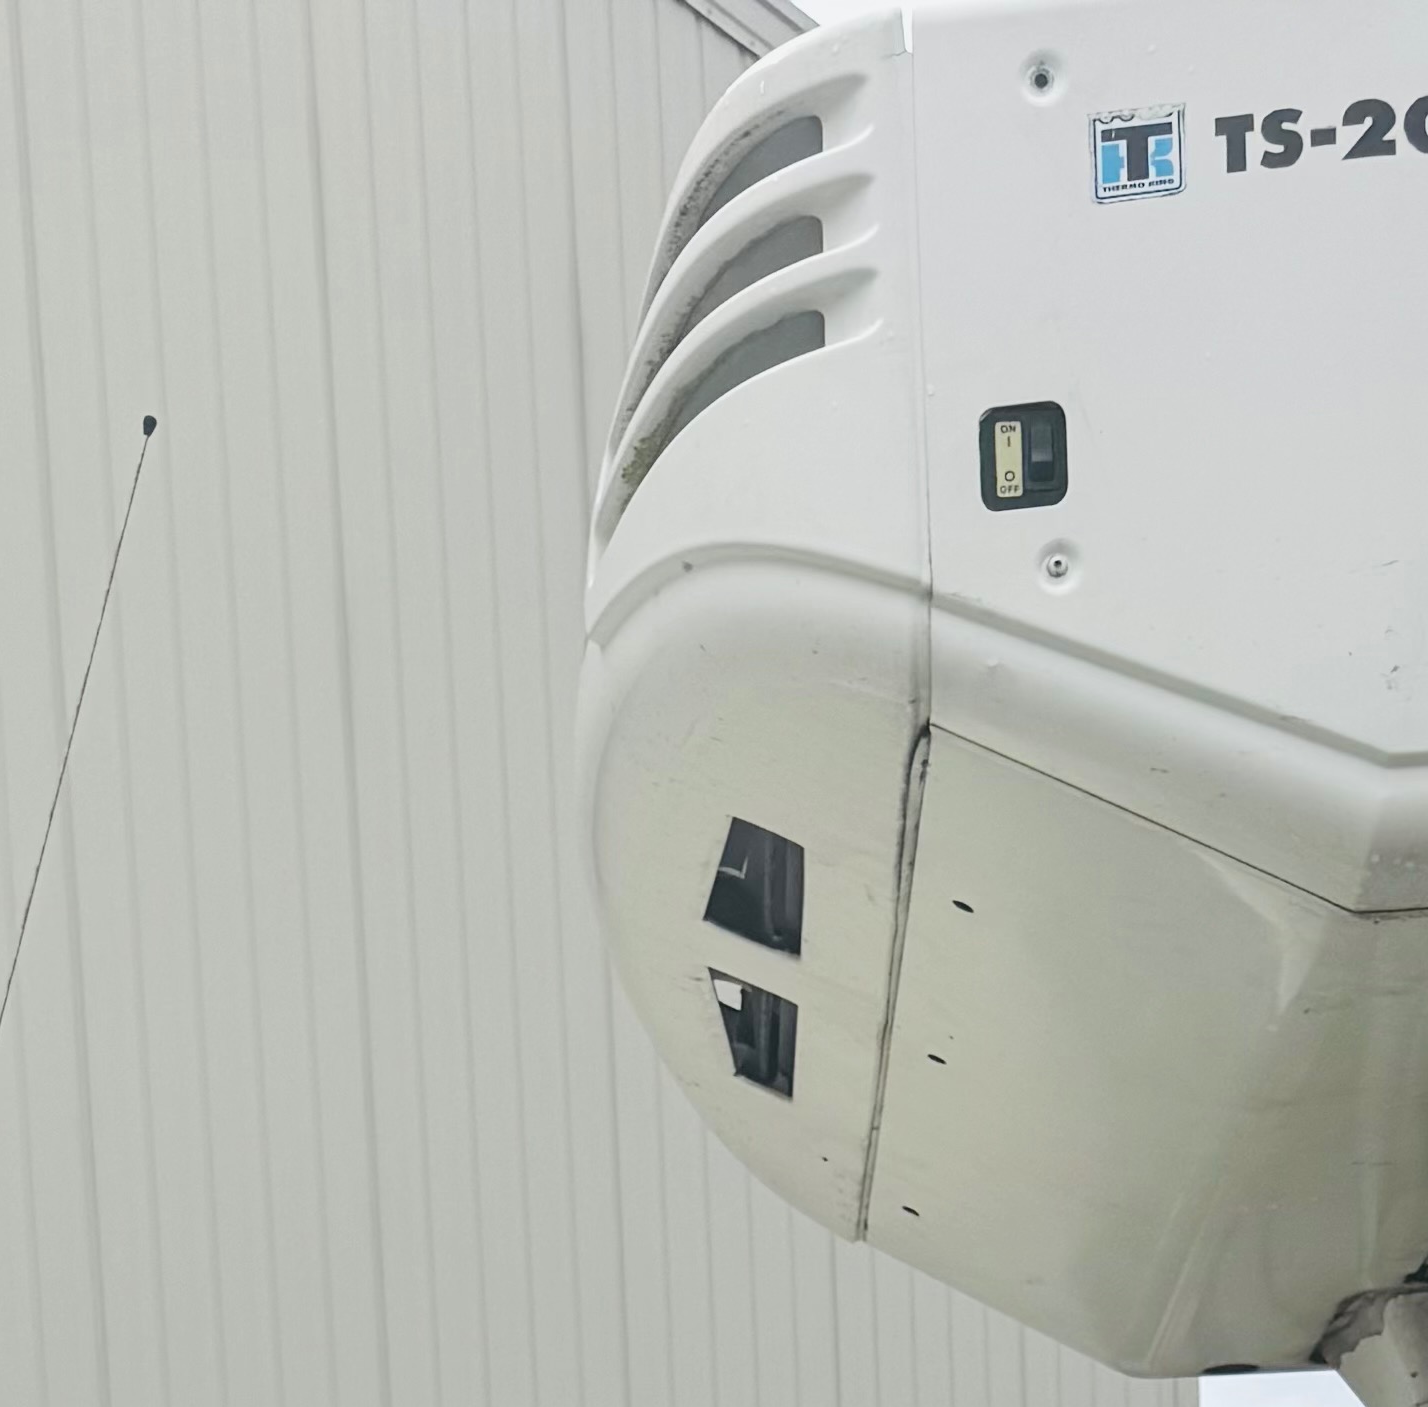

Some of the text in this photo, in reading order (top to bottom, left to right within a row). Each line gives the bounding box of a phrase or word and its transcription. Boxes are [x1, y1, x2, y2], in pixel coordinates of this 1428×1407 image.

[1103, 182, 1145, 192] THERMO
[1000, 424, 1016, 434] ON
[999, 484, 1020, 494] OFF
